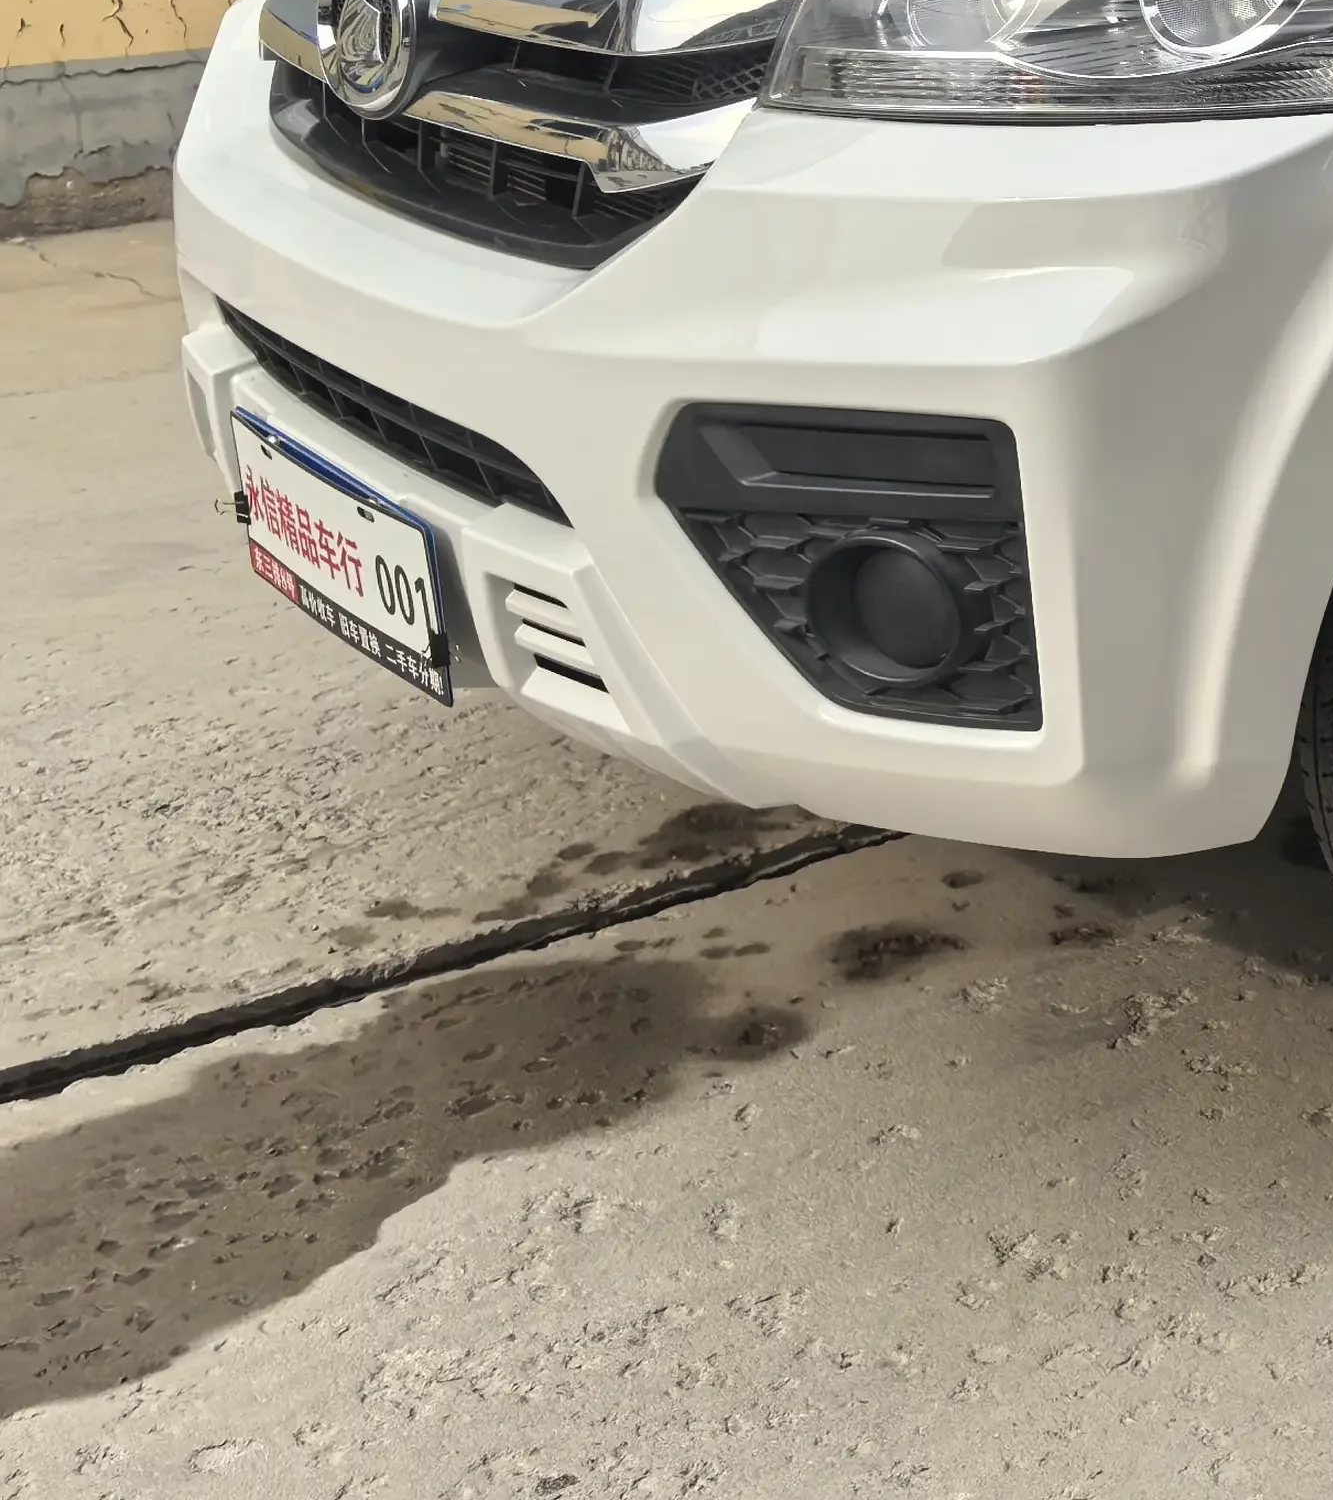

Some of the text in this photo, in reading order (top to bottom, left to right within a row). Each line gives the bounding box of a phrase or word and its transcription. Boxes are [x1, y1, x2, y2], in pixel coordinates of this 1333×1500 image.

[244, 464, 434, 636] 永信精品车行 001
